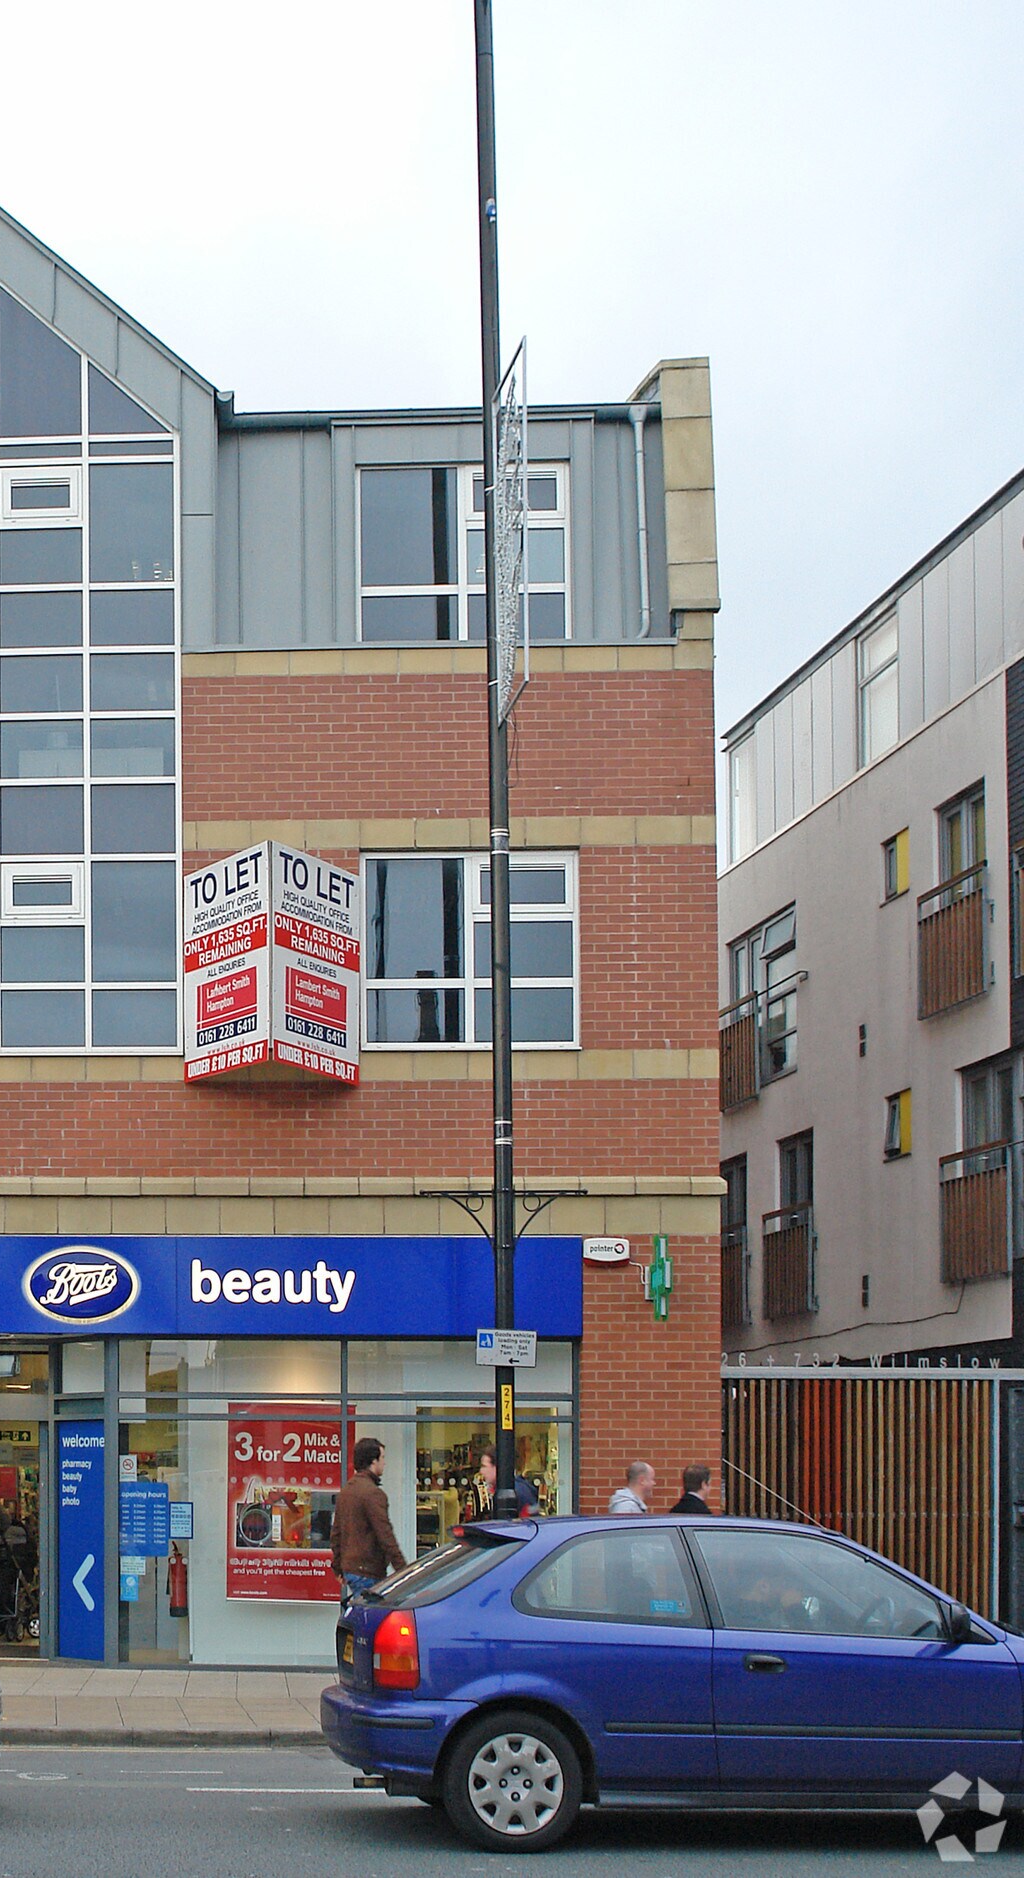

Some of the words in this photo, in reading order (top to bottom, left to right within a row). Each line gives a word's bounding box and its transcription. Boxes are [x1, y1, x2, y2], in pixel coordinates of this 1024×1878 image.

[190, 873, 217, 908] TO
[224, 851, 263, 896] LET
[279, 851, 308, 890] TO
[317, 866, 354, 908] LET
[191, 909, 242, 936] ACCOMMODATION
[243, 900, 262, 916] FROM
[194, 912, 208, 923] HIGH
[209, 899, 235, 918] QUALITY
[237, 889, 259, 907] OFFICE
[281, 901, 334, 929] ACCOMMODATION
[336, 921, 353, 937] FROM
[283, 889, 299, 904] HIGH
[300, 897, 327, 914] QUALITY
[328, 908, 350, 924] OFFICE
[184, 937, 211, 956] ONLY
[211, 928, 235, 947] 1,635
[236, 916, 268, 936] SQ.FT.
[275, 915, 303, 934] ONLY
[304, 925, 329, 944] 1,635
[330, 936, 360, 955] SQ.FT.
[198, 936, 252, 966] REMAINING
[291, 935, 345, 964] REMAINING
[207, 967, 217, 978] ALL
[218, 957, 246, 975] ENQUIRIES
[297, 958, 308, 969] ALL
[309, 962, 337, 979] ENQUIRIES
[206, 981, 231, 999] Lambert
[232, 975, 251, 990] Smith
[296, 975, 321, 994] Lambert
[322, 983, 340, 1000] Smith
[296, 989, 324, 1009] Hampton
[206, 997, 234, 1013] Hampton
[198, 1030, 216, 1045] 0161
[219, 1024, 234, 1039] 228
[237, 1017, 255, 1033] 6411
[288, 1017, 306, 1033] 0161
[308, 1024, 324, 1039] 228
[326, 1029, 345, 1046] 6411
[187, 1058, 210, 1078] UNDER
[212, 1053, 227, 1072] £10
[227, 1049, 241, 1068] PER
[277, 1043, 303, 1065] UNDER
[304, 1052, 318, 1070] £10
[319, 1056, 334, 1075] PER
[589, 1245, 613, 1254] pointer
[39, 1262, 119, 1306] Boots
[191, 1258, 356, 1313] beauty
[513, 1331, 535, 1339] vehicles
[794, 1353, 840, 1367] 732
[869, 1354, 1001, 1368] Wilmslow
[62, 1433, 105, 1448] welcome
[234, 1431, 254, 1462] 3
[256, 1445, 281, 1462] for
[282, 1432, 302, 1463] 2
[304, 1433, 328, 1447] Mix
[330, 1434, 341, 1447] &
[62, 1459, 92, 1470] pharmacy
[62, 1472, 82, 1482] beauty
[62, 1484, 77, 1495] baby
[62, 1497, 80, 1507] photo
[121, 1491, 146, 1499] opening
[263, 1568, 273, 1576] get
[285, 1568, 312, 1577] cheapest
